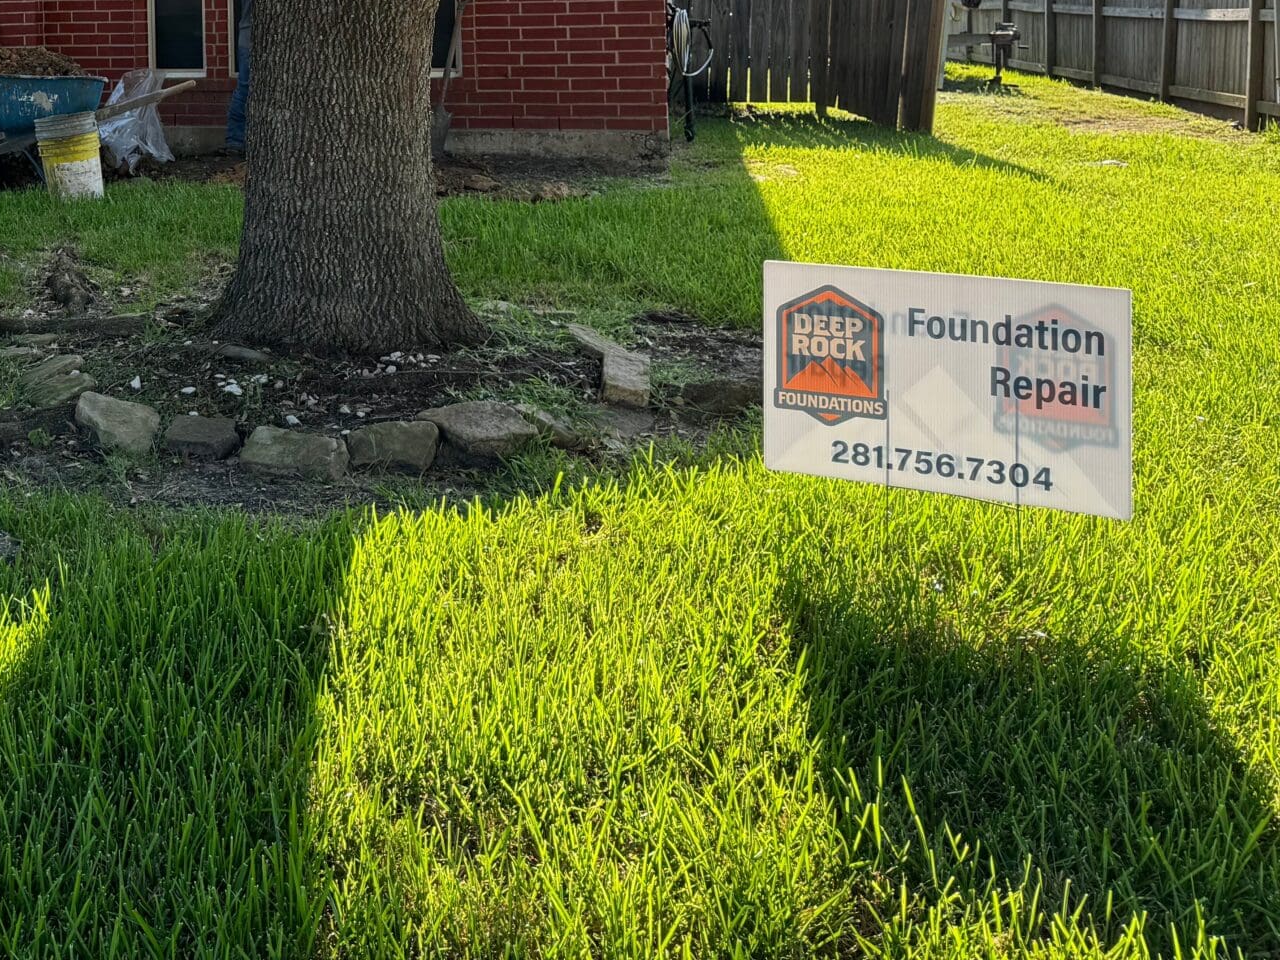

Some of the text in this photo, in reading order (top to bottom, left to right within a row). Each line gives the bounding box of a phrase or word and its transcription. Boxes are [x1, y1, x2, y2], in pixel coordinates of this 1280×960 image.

[793, 312, 864, 339] DEEP
[907, 307, 1105, 357] Foundation
[791, 333, 866, 362] ROCK
[778, 391, 884, 416] FOUNDATIONS
[990, 366, 1107, 410] Repair
[831, 440, 1054, 492] 281.756.7304
